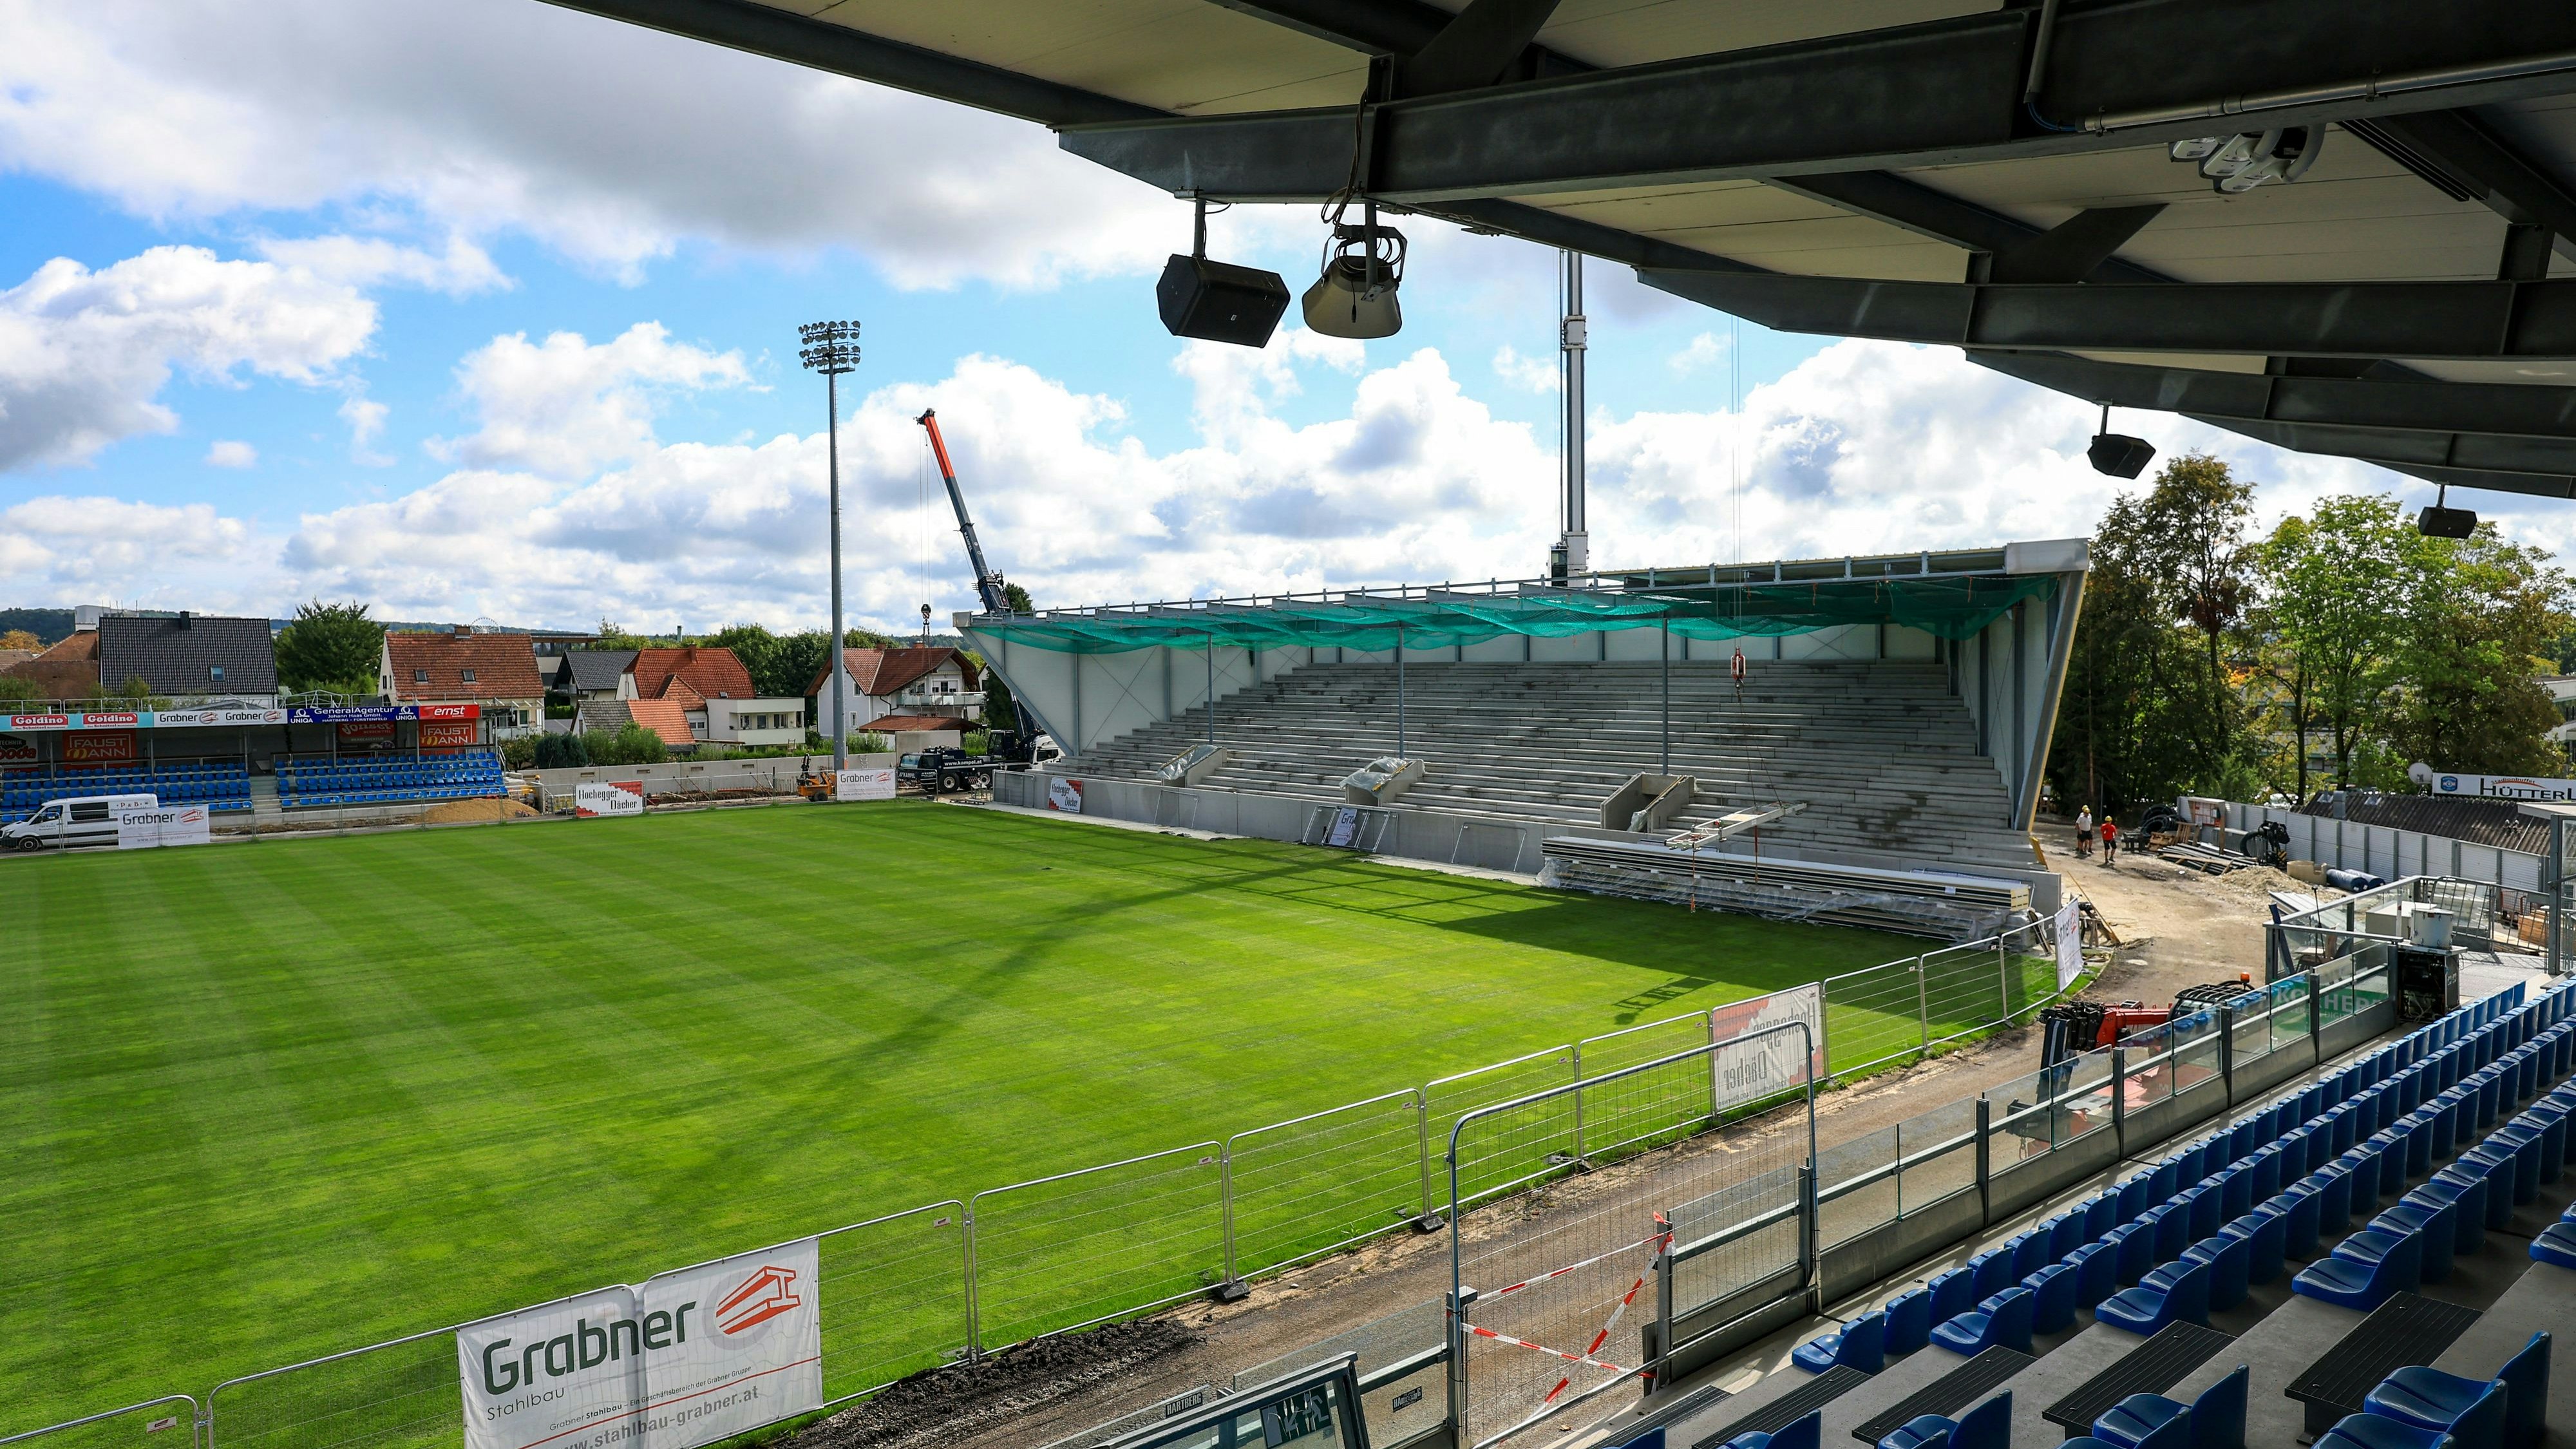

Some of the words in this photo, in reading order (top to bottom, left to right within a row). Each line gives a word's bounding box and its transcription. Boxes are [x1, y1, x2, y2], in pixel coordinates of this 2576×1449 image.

[314, 706, 395, 715] GeneralAgentur
[434, 706, 465, 715] ernst
[15, 715, 64, 724] Goldino
[88, 714, 133, 723] Goldino
[160, 713, 198, 723] Grabner
[225, 712, 263, 721] Grabner
[427, 727, 468, 735] FAUST
[75, 738, 127, 748] FAUST
[840, 773, 874, 783] Grabner
[579, 789, 618, 801] Hochegger
[611, 799, 638, 810] Dächer
[123, 813, 175, 825] Grabner
[483, 1301, 697, 1396] Grabner
[549, 1414, 584, 1431] Grabner
[586, 1404, 622, 1419] Stahlbau
[630, 1398, 640, 1406] Ein
[641, 1383, 695, 1403] Geschäftsbereich
[696, 1379, 706, 1388] der
[707, 1372, 730, 1385] Grabner
[731, 1365, 752, 1378] Gruppe
[487, 1387, 565, 1420] Stahlbau
[1167, 1393, 1202, 1416] HARTBERG
